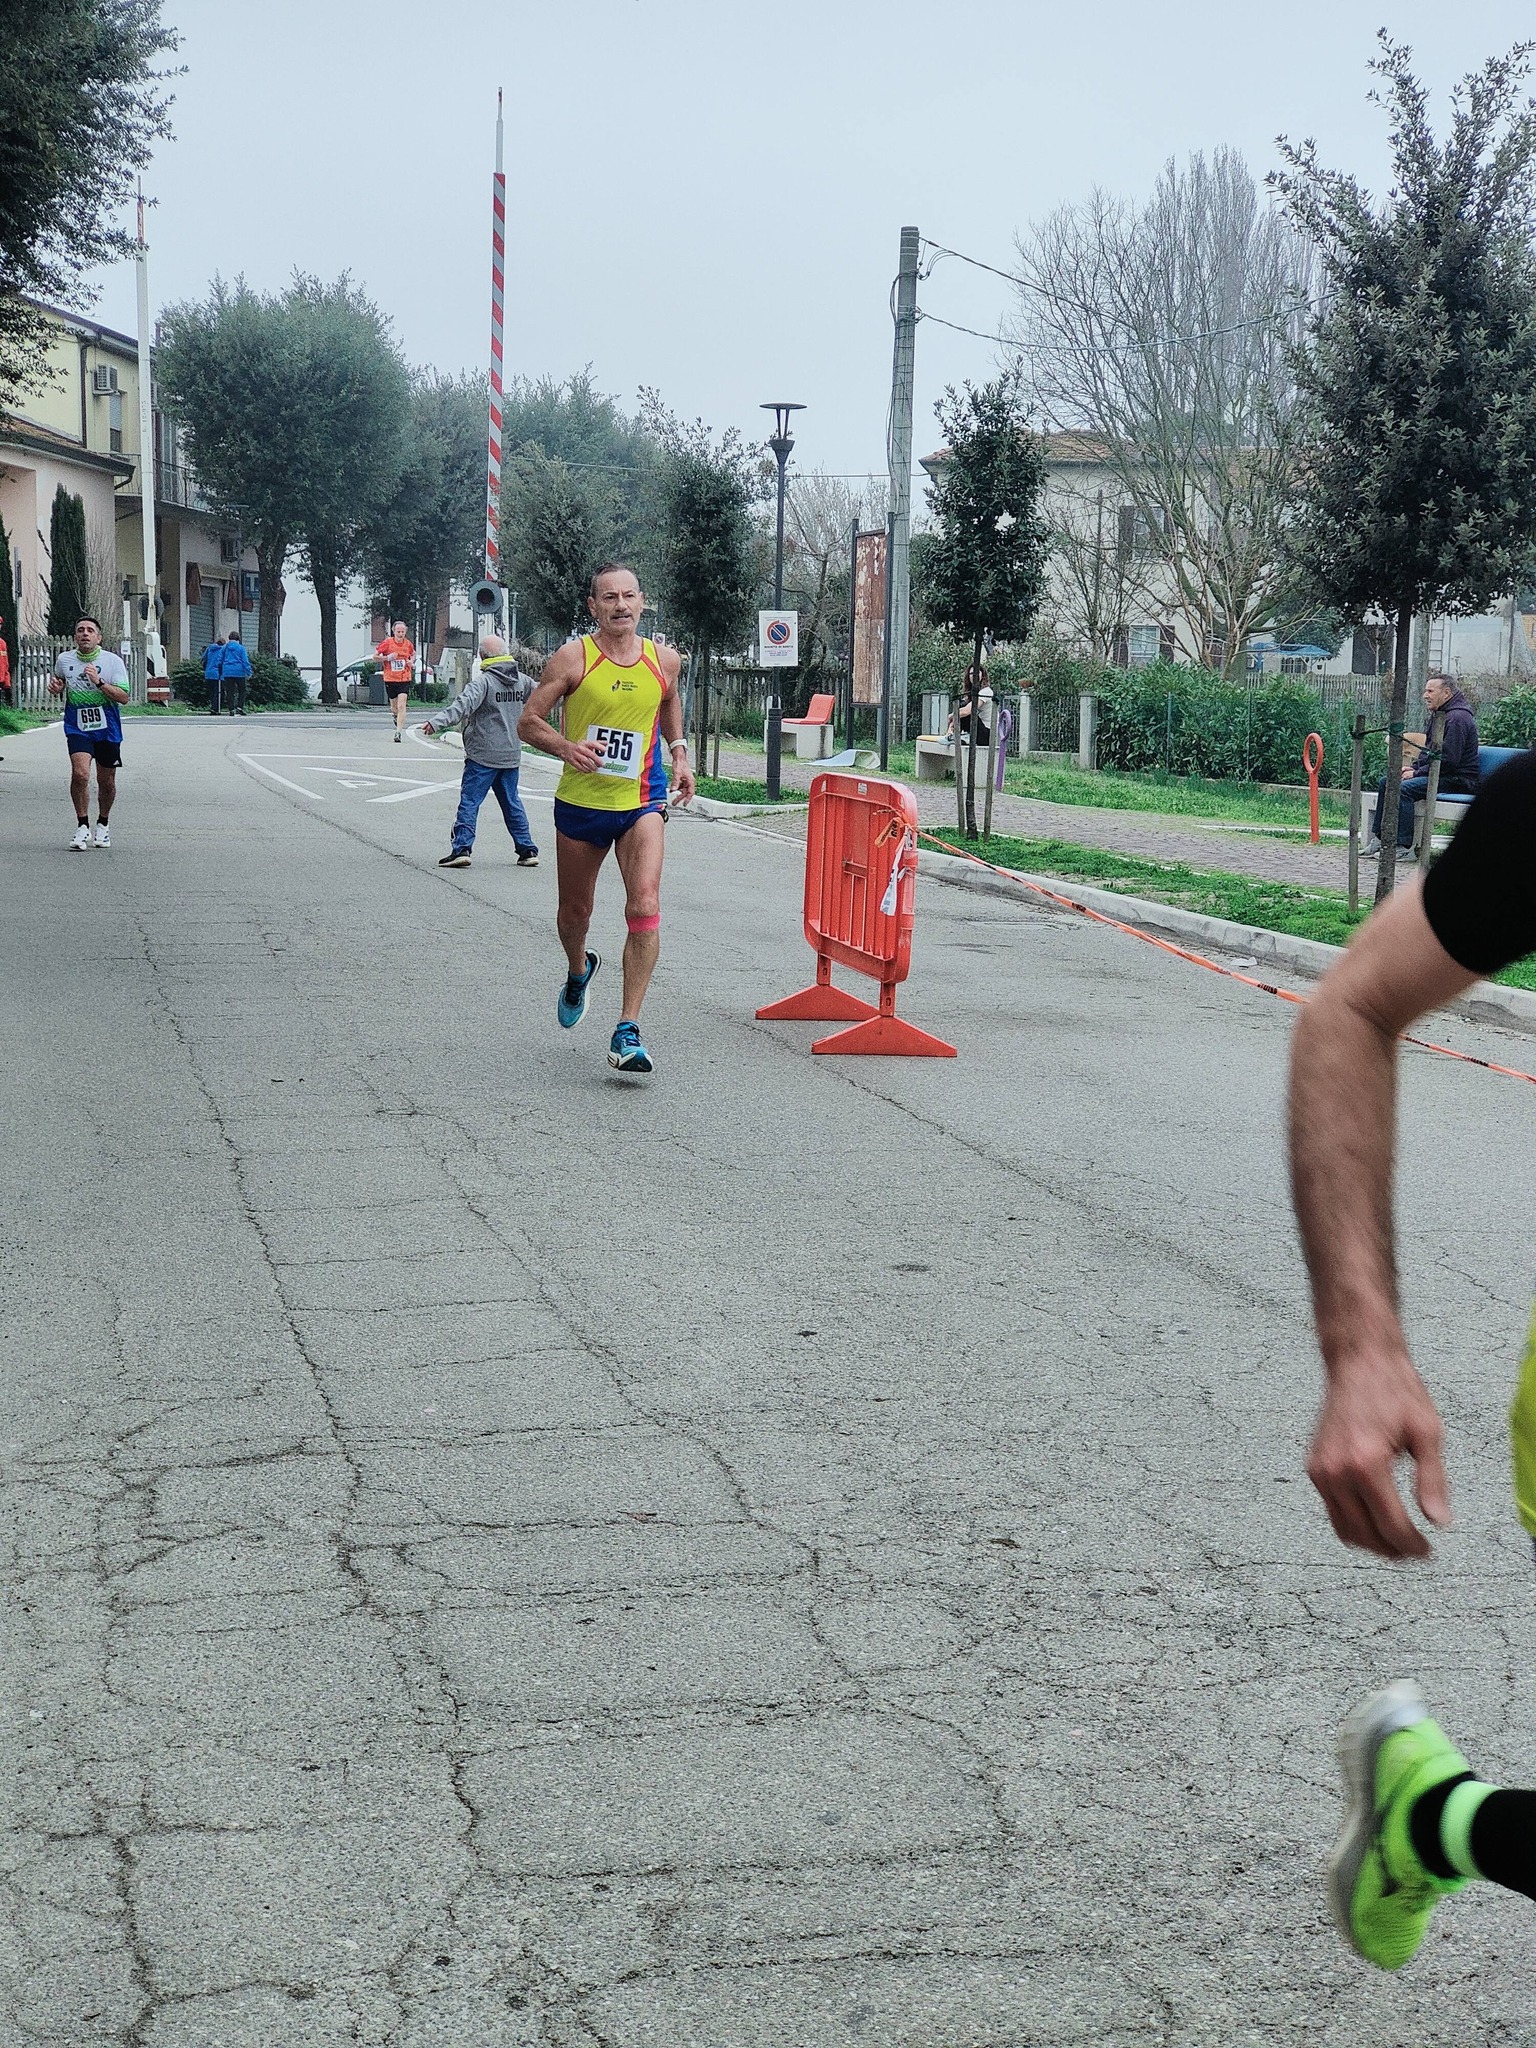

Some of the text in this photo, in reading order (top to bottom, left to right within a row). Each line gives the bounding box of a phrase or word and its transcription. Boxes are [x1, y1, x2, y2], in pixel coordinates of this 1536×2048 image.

[495, 691, 524, 702] GIUDICE
[81, 709, 102, 723] 699
[595, 728, 634, 761] 555
